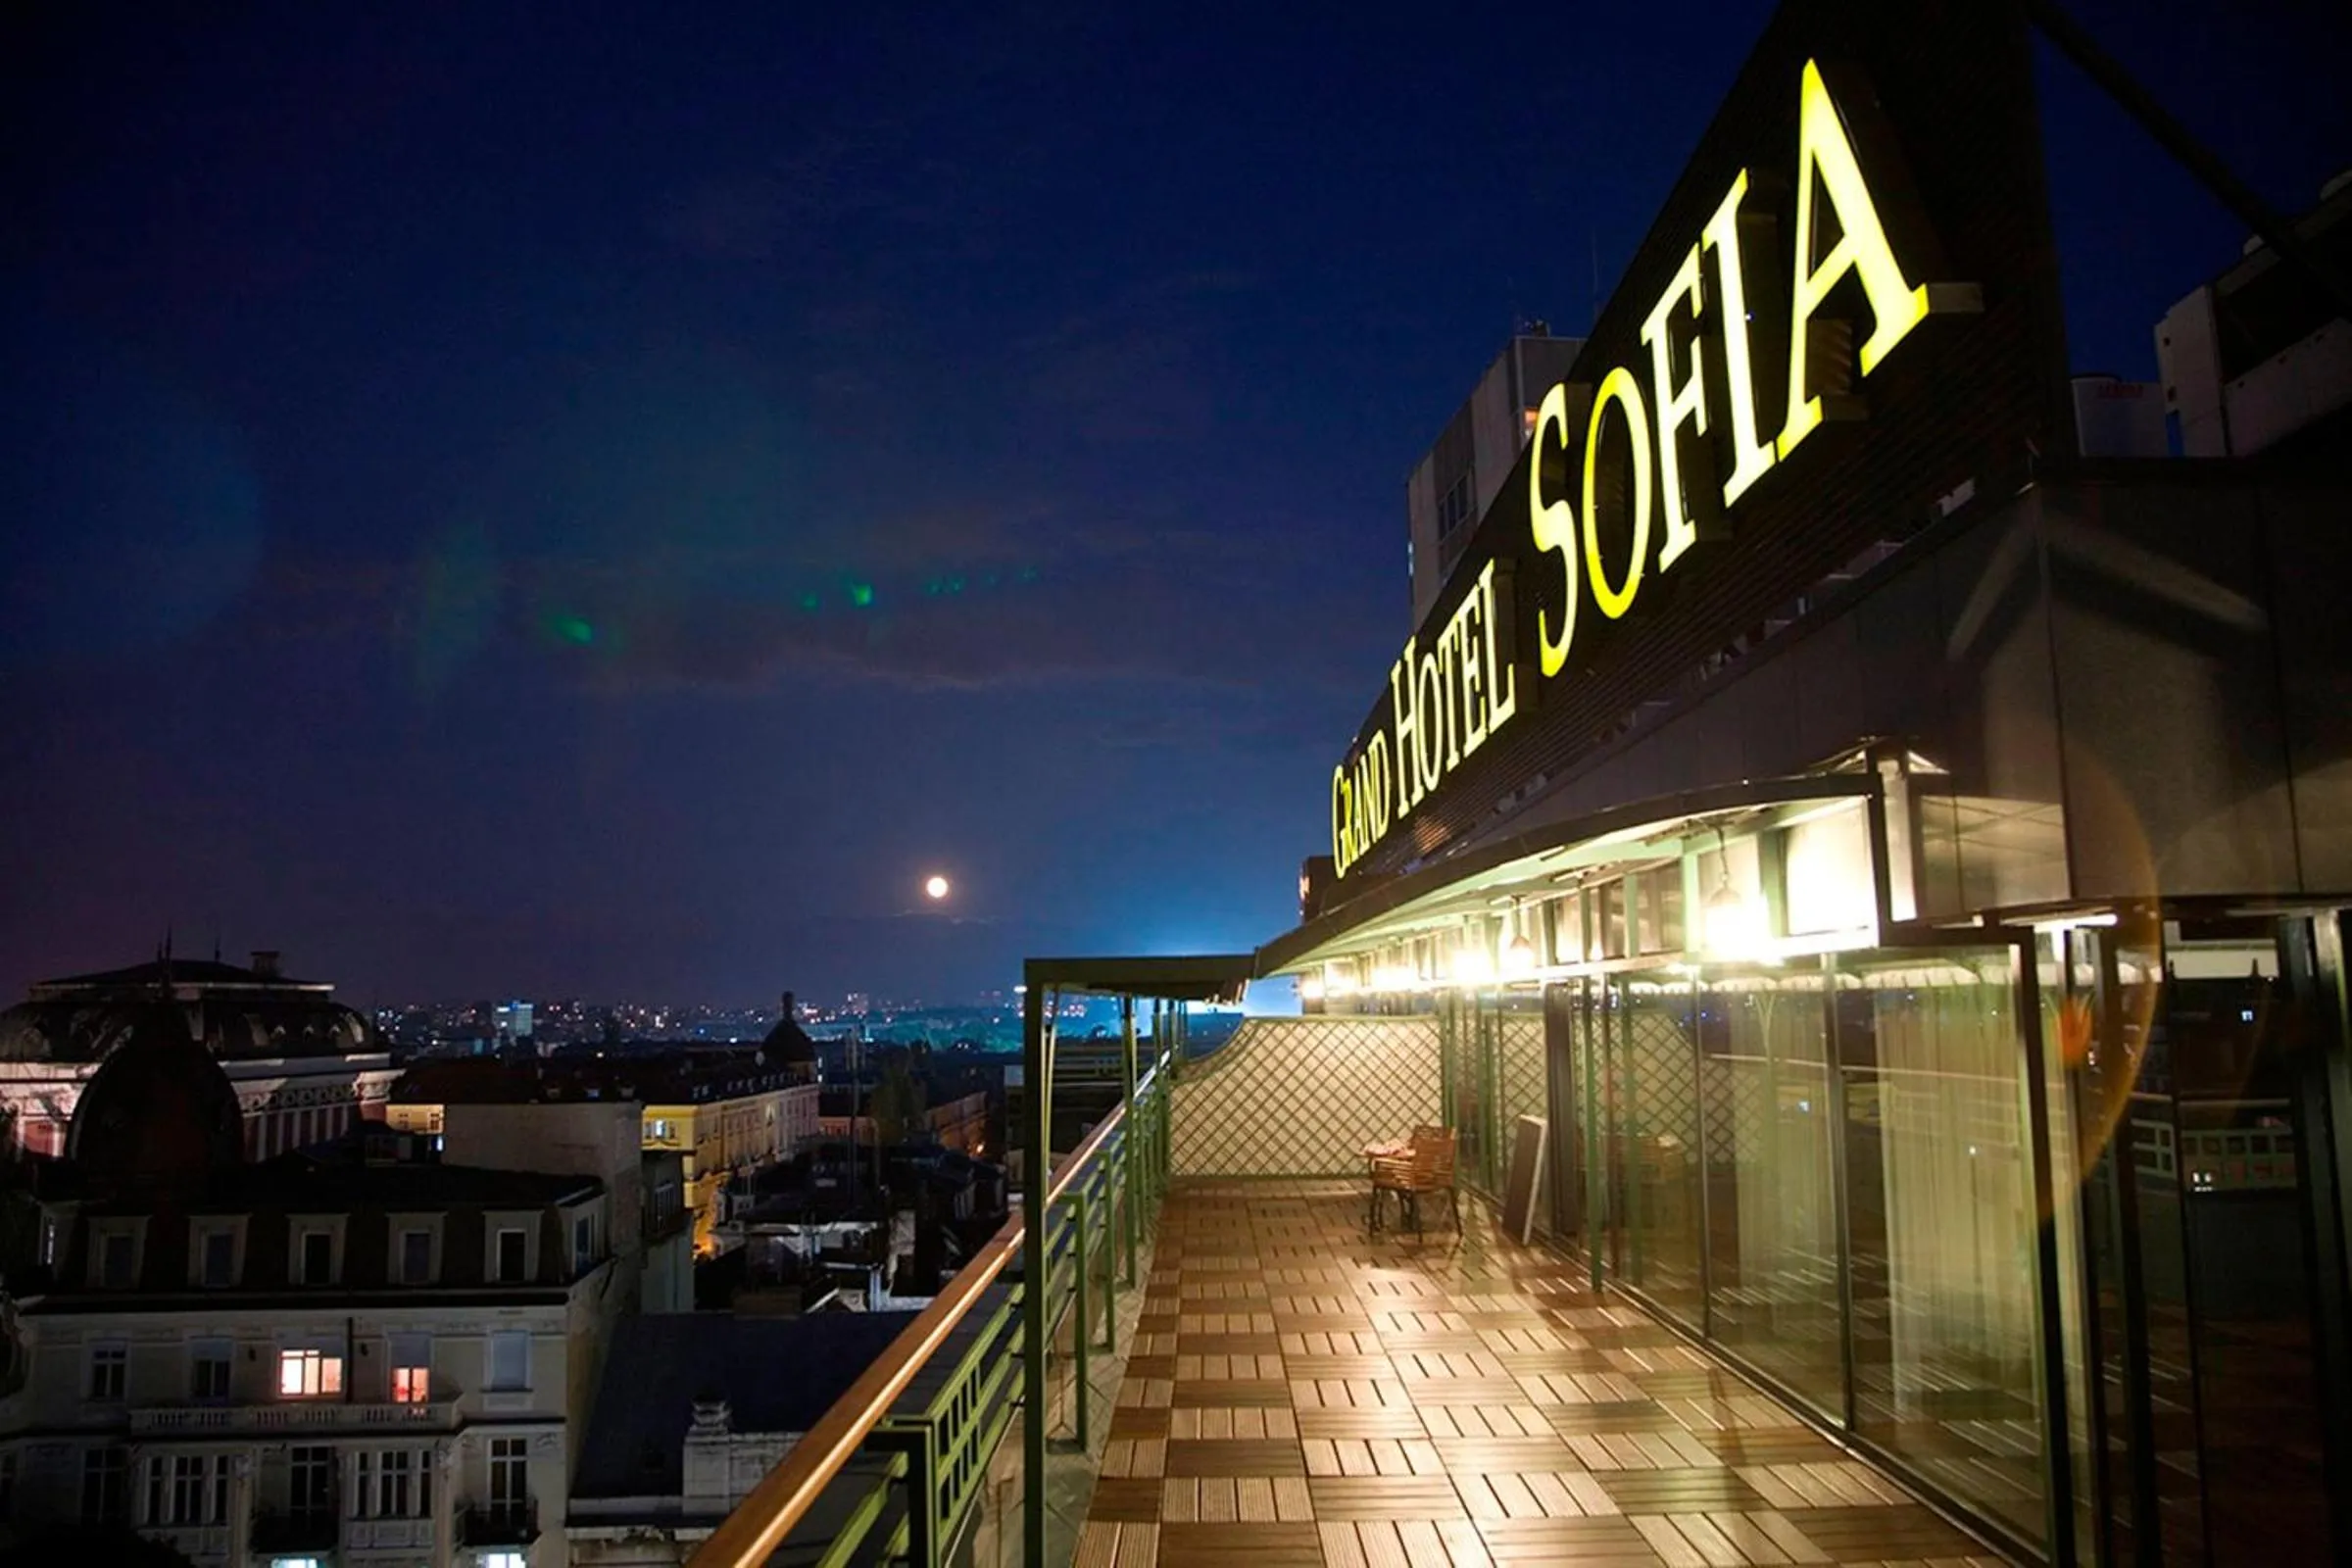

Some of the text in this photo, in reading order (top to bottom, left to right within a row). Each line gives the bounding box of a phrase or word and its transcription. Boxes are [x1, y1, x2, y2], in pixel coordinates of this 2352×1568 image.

[1332, 58, 1930, 879] GRAND HOTEL SOFIA
